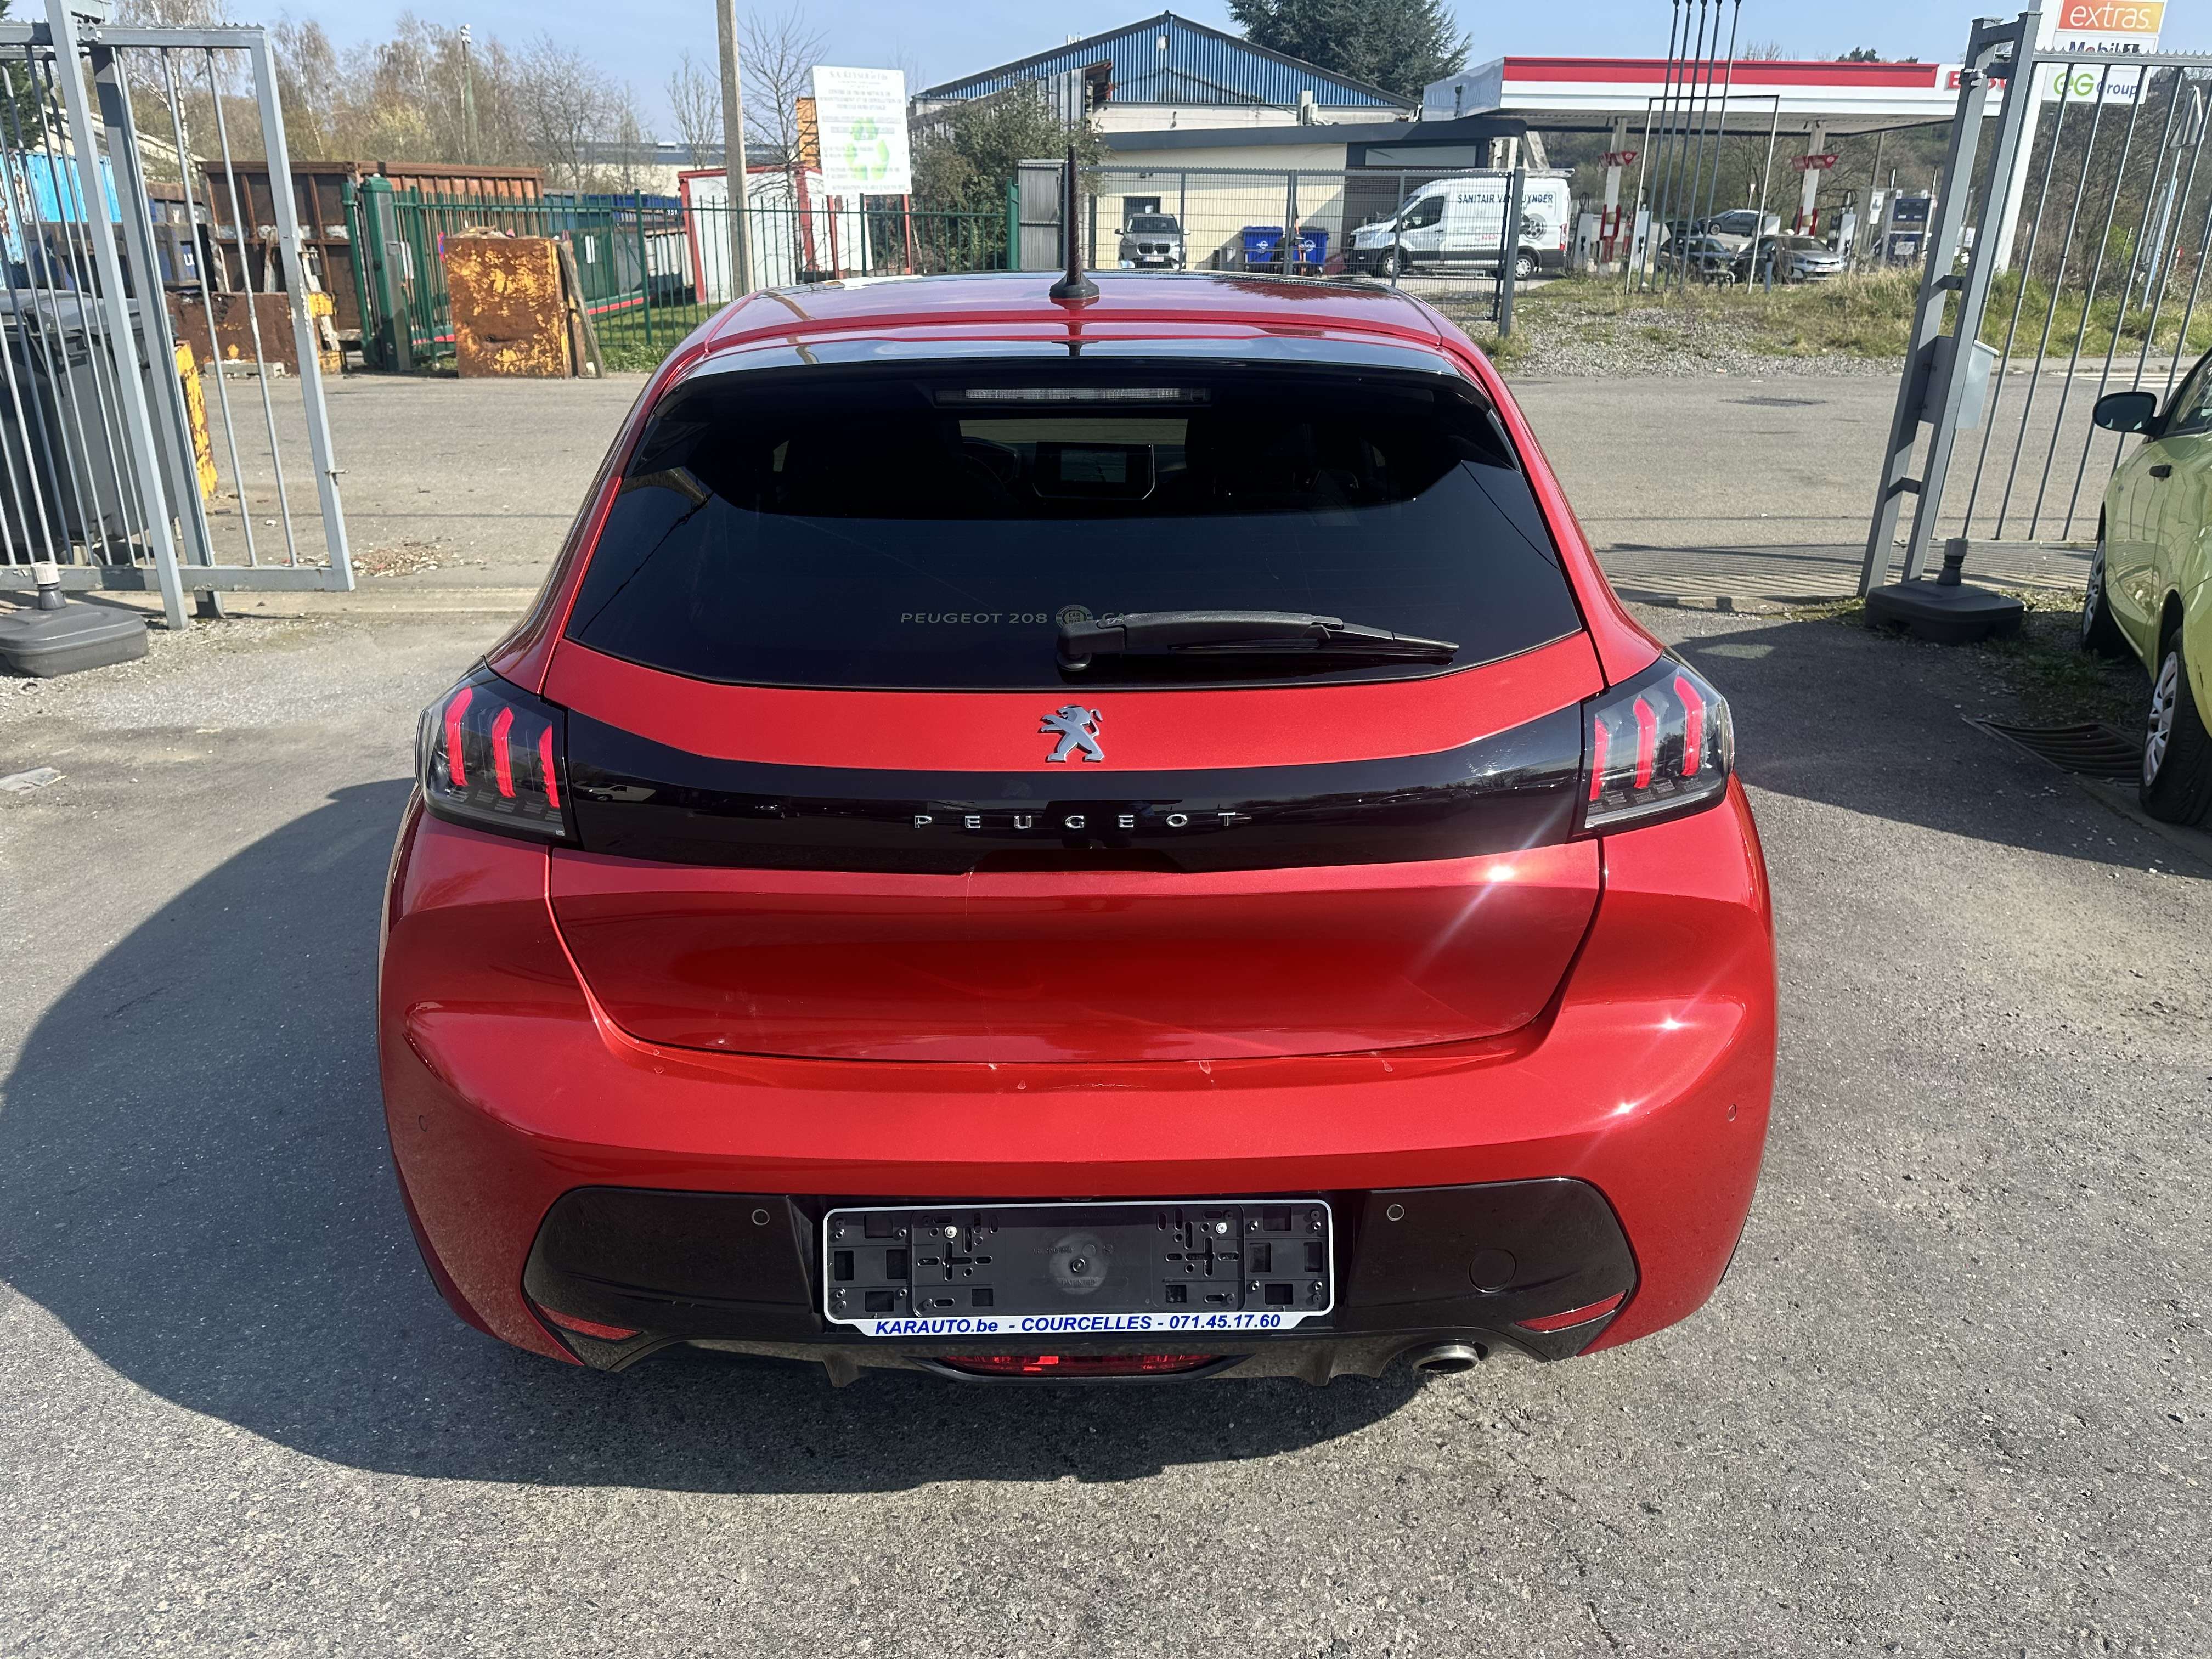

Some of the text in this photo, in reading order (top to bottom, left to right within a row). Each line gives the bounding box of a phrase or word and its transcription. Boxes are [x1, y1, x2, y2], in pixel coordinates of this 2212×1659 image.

[2069, 2, 2151, 29] extras
[1458, 194, 1494, 204] SANITAIR
[1521, 194, 1553, 204] UYNDER
[900, 613, 1048, 624] PEUGEOT 208
[913, 811, 1237, 829] PEUGEOT
[876, 1319, 998, 1334] KARAUTO.be
[1021, 1316, 1152, 1331] COURCELLES
[1169, 1314, 1281, 1329] 071.45.17.60
